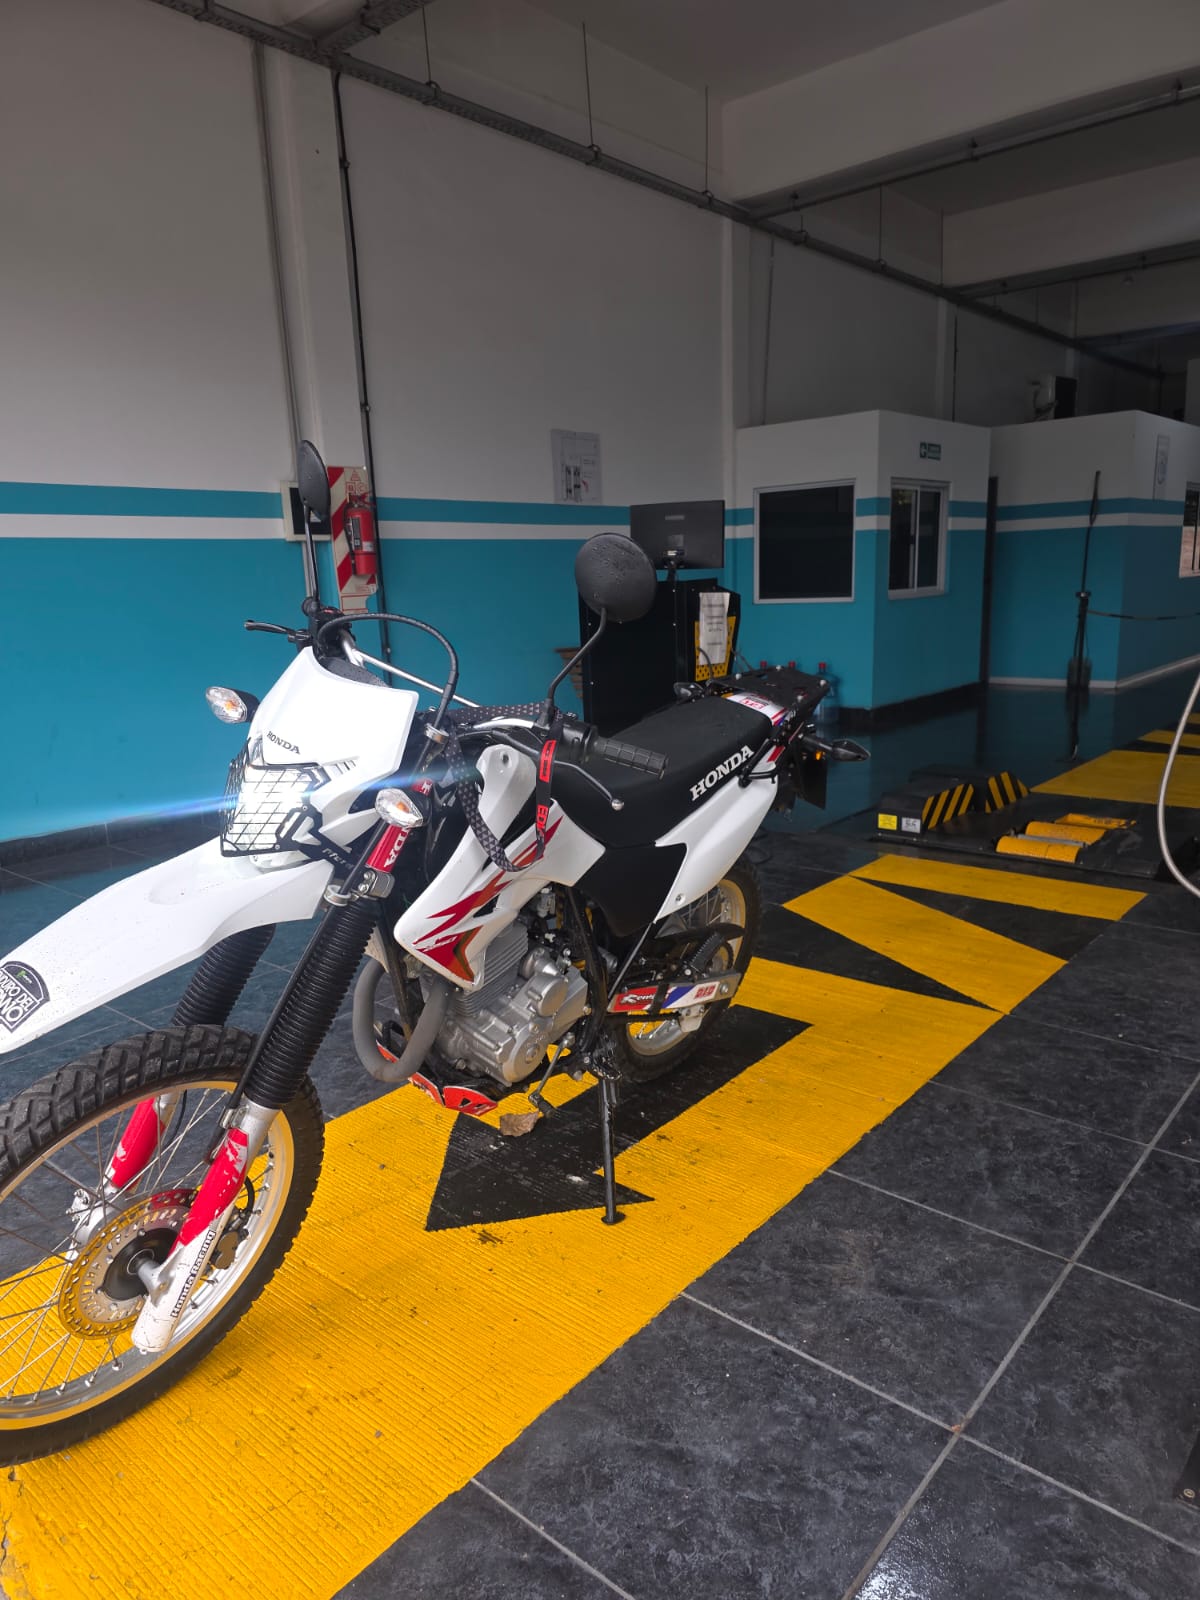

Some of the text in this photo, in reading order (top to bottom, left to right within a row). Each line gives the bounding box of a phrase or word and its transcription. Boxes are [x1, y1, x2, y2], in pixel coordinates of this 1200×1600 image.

[266, 730, 301, 755] HONDA
[689, 744, 755, 801] HONDA
[0, 970, 21, 997] DURO
[15, 992, 35, 1012] DEL
[170, 1229, 217, 1318] Honda Racing
